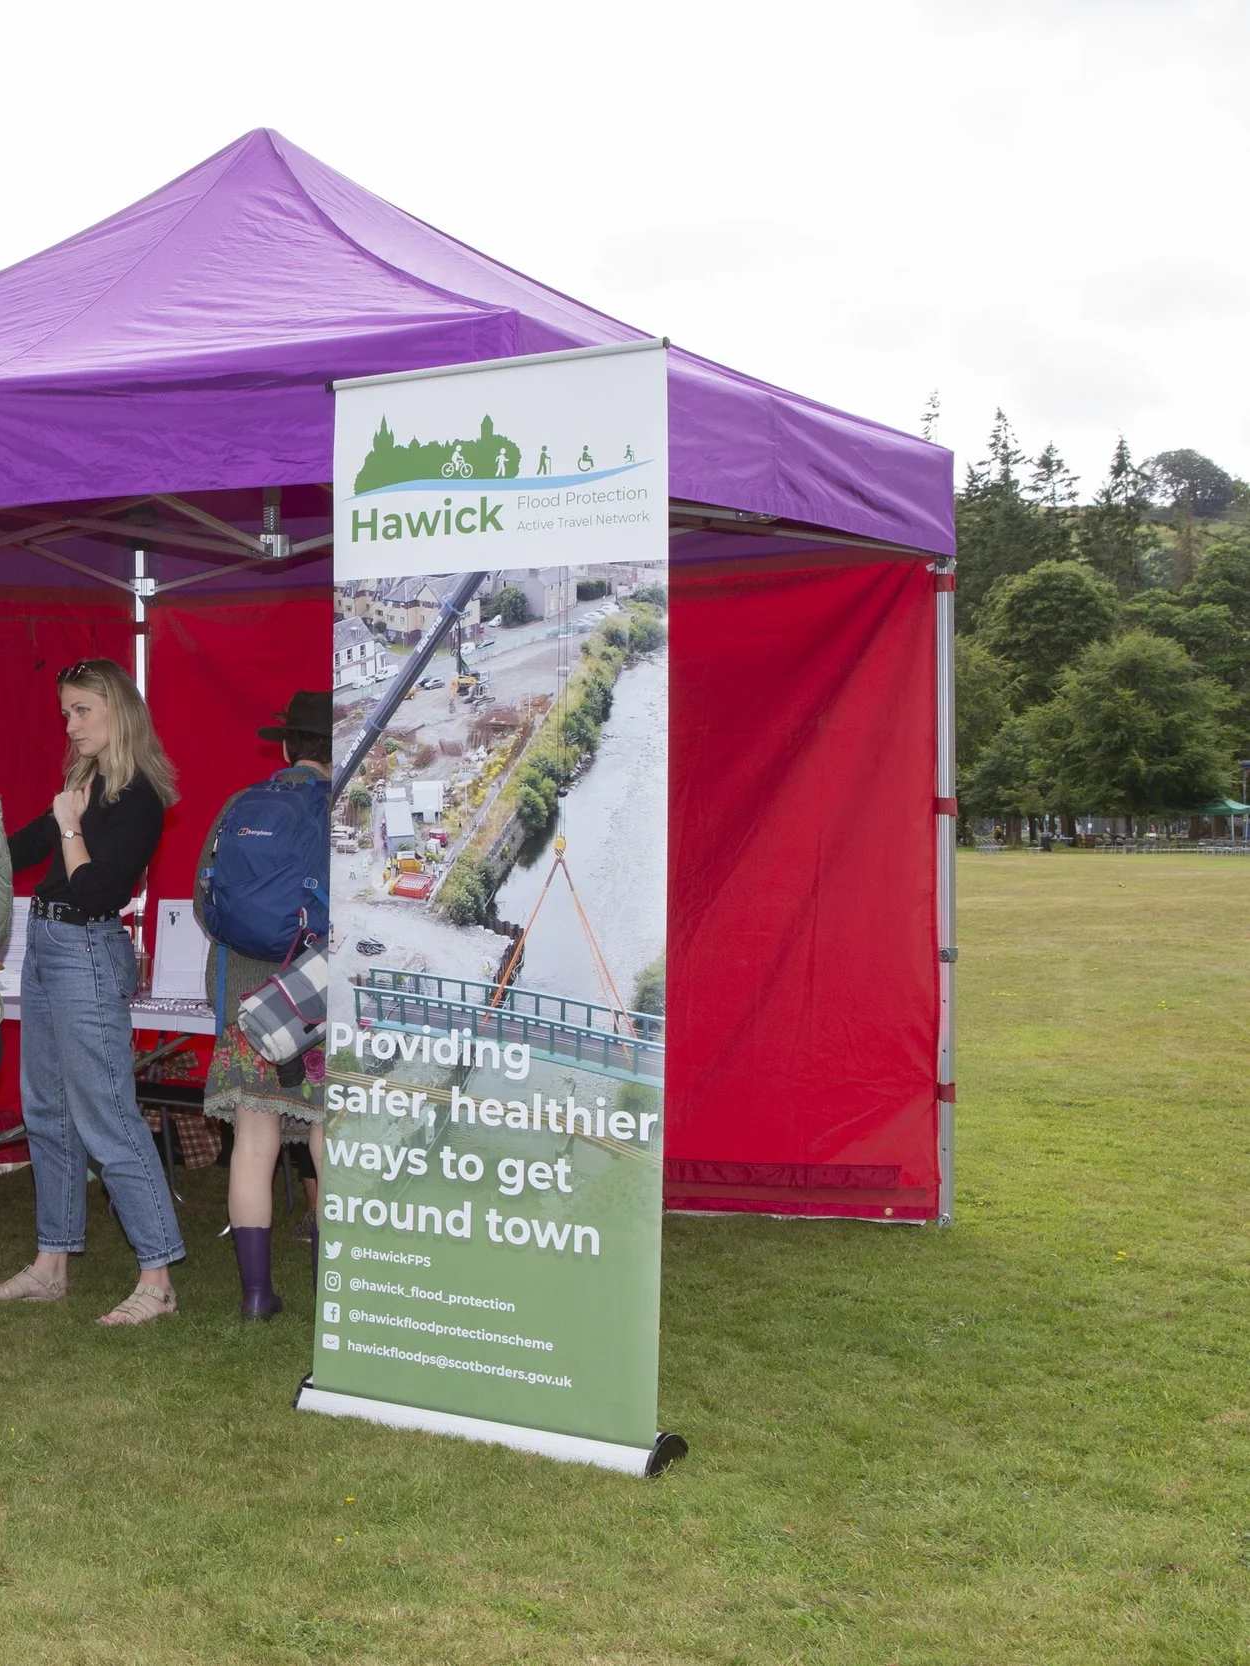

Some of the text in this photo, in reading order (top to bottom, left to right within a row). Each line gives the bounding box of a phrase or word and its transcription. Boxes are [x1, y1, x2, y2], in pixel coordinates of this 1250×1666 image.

[351, 496, 505, 543] Hawick
[517, 486, 648, 510] Flood Protection
[517, 510, 650, 532] Active Travel Network
[329, 1021, 531, 1080] Providing
[327, 1079, 658, 1143] safer, healthier
[326, 1137, 574, 1197] ways to get
[324, 1192, 601, 1256] around town
[350, 1246, 432, 1268] @HawickFPS
[349, 1277, 516, 1313] @hawick_flood_protection
[348, 1308, 554, 1352] @hawickfloodprotectionscheme
[347, 1339, 573, 1390] hawickfloodps@scotborders.gov.uk
